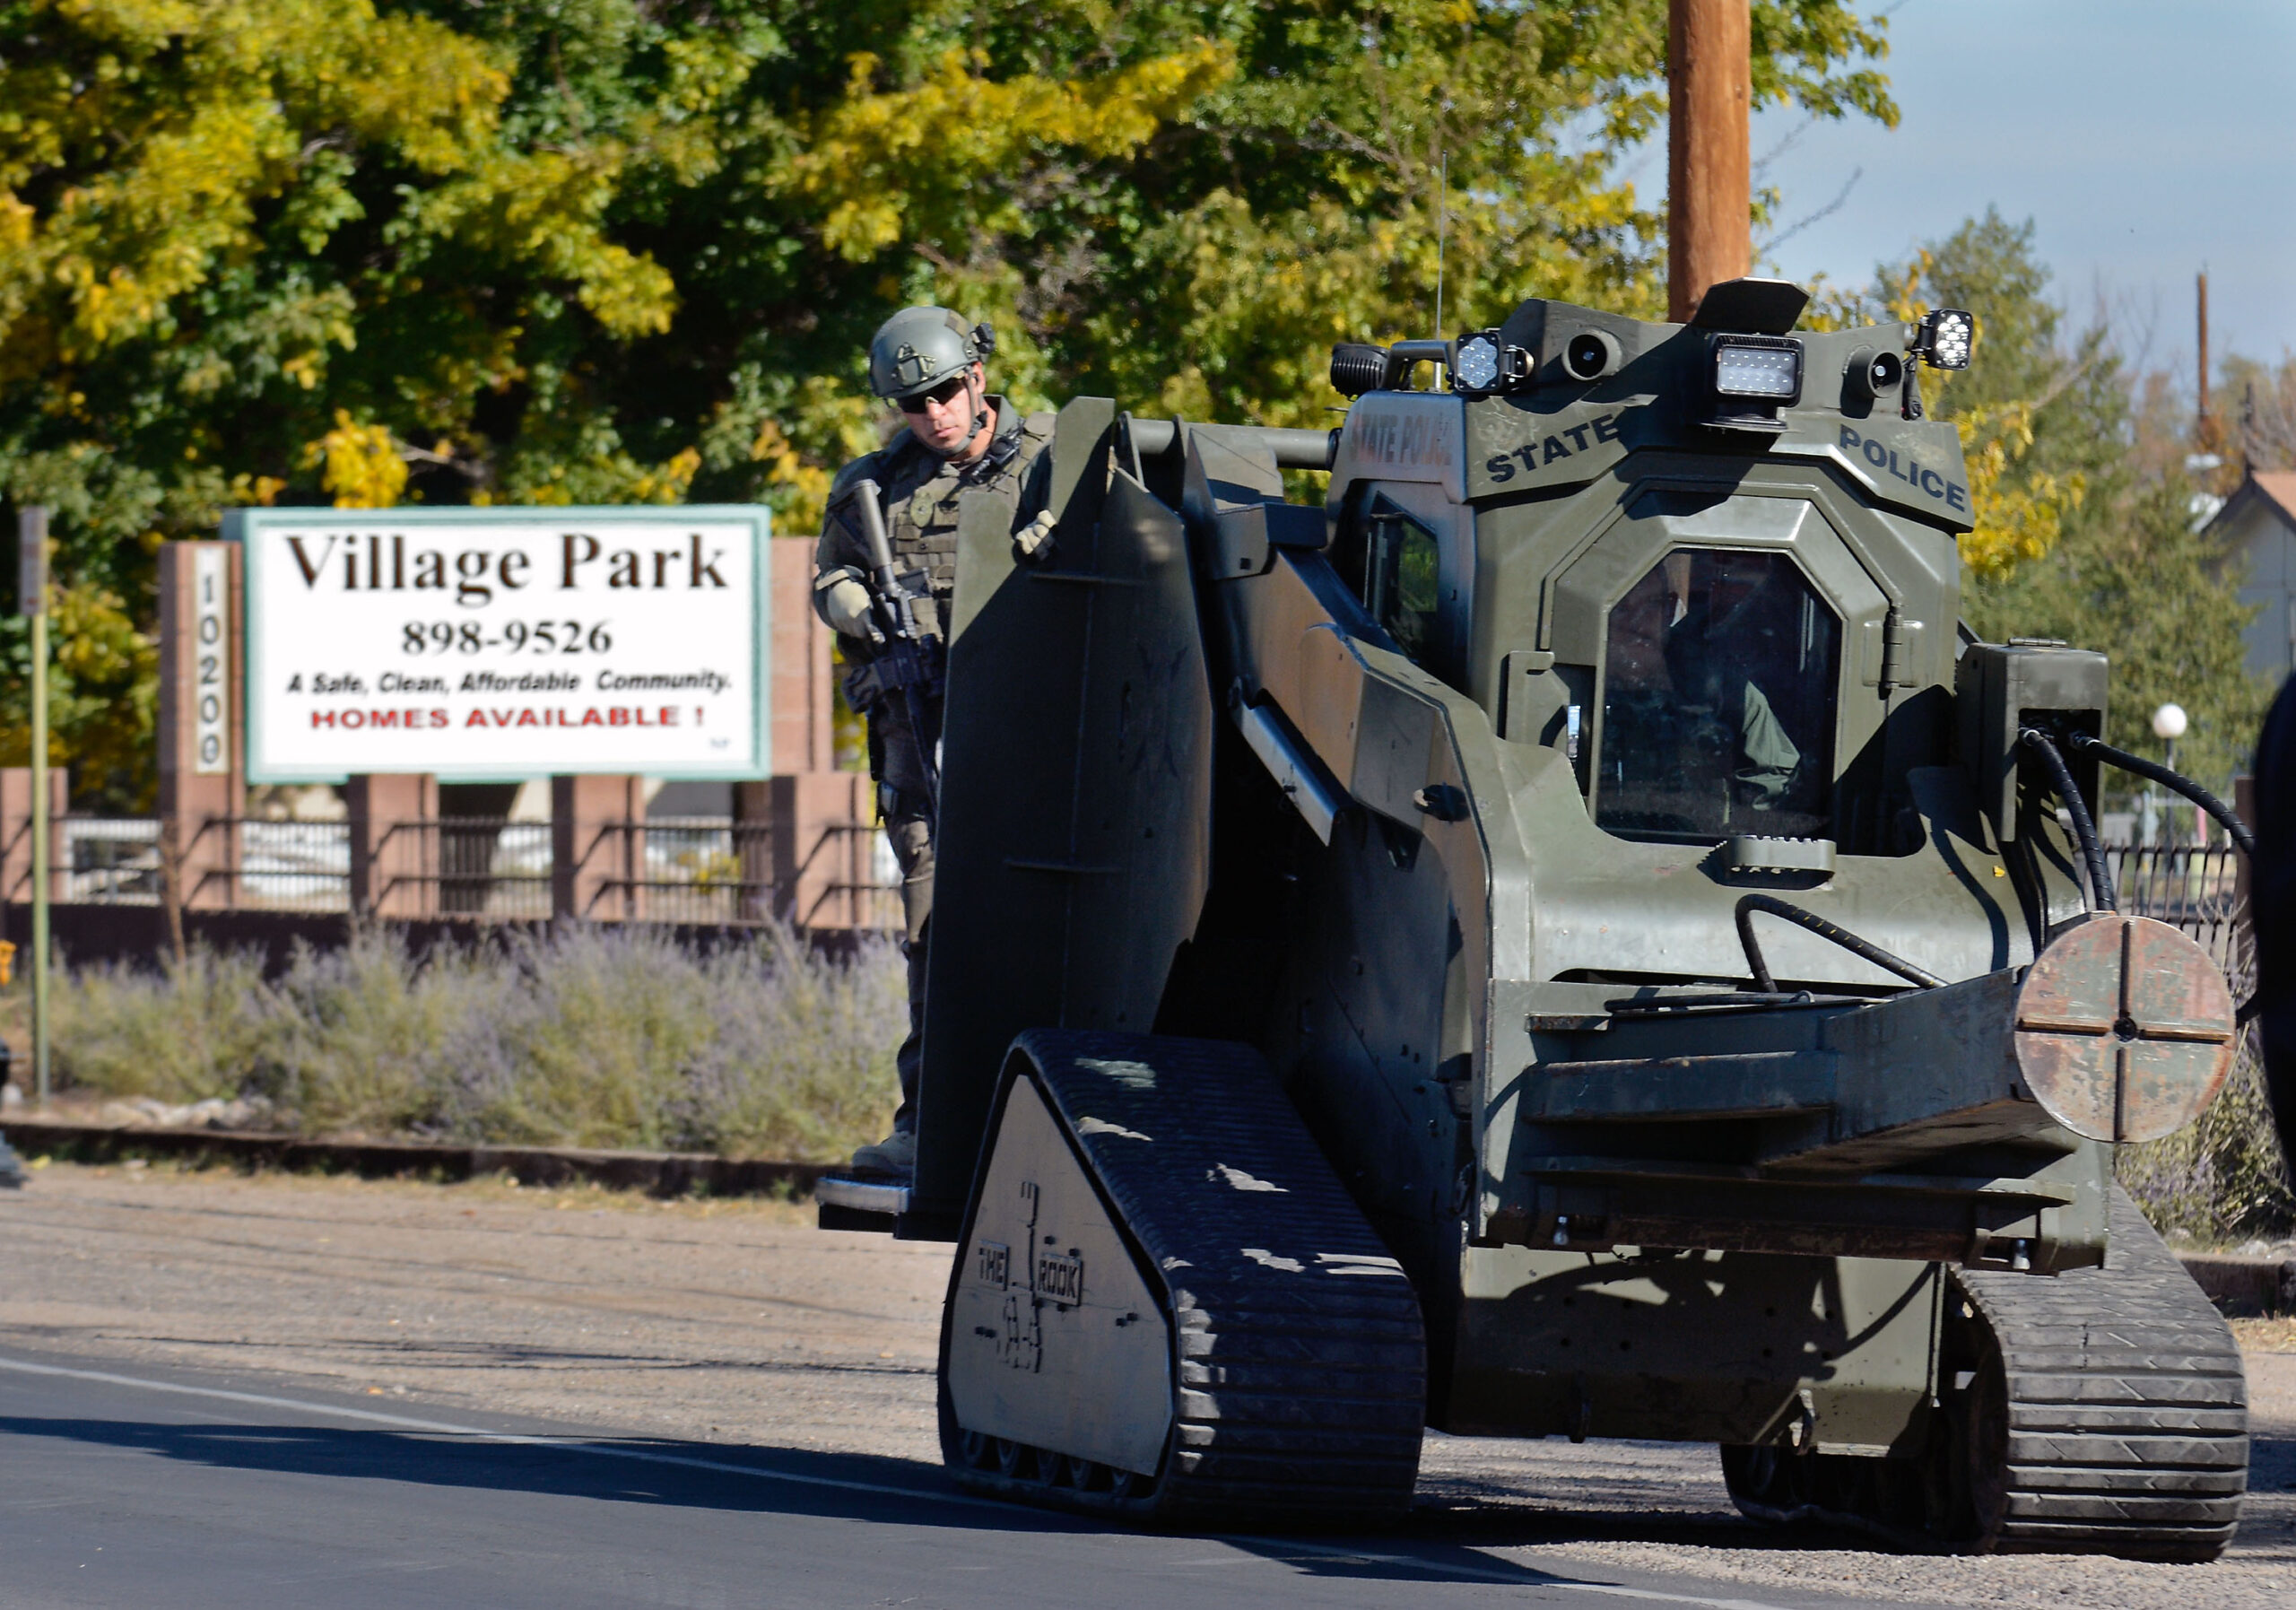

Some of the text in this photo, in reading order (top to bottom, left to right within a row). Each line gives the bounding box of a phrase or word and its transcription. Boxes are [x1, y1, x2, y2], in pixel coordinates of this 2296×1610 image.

[1486, 413, 1620, 483] STATE
[1839, 423, 1965, 512] POLICE
[285, 533, 728, 607] Village Park
[401, 620, 613, 655] 898-9526
[286, 668, 733, 695] A Safe, Clean, Affordable Community.
[310, 706, 704, 729] HOMES AVAILABLE !
[978, 1246, 1005, 1284] THE
